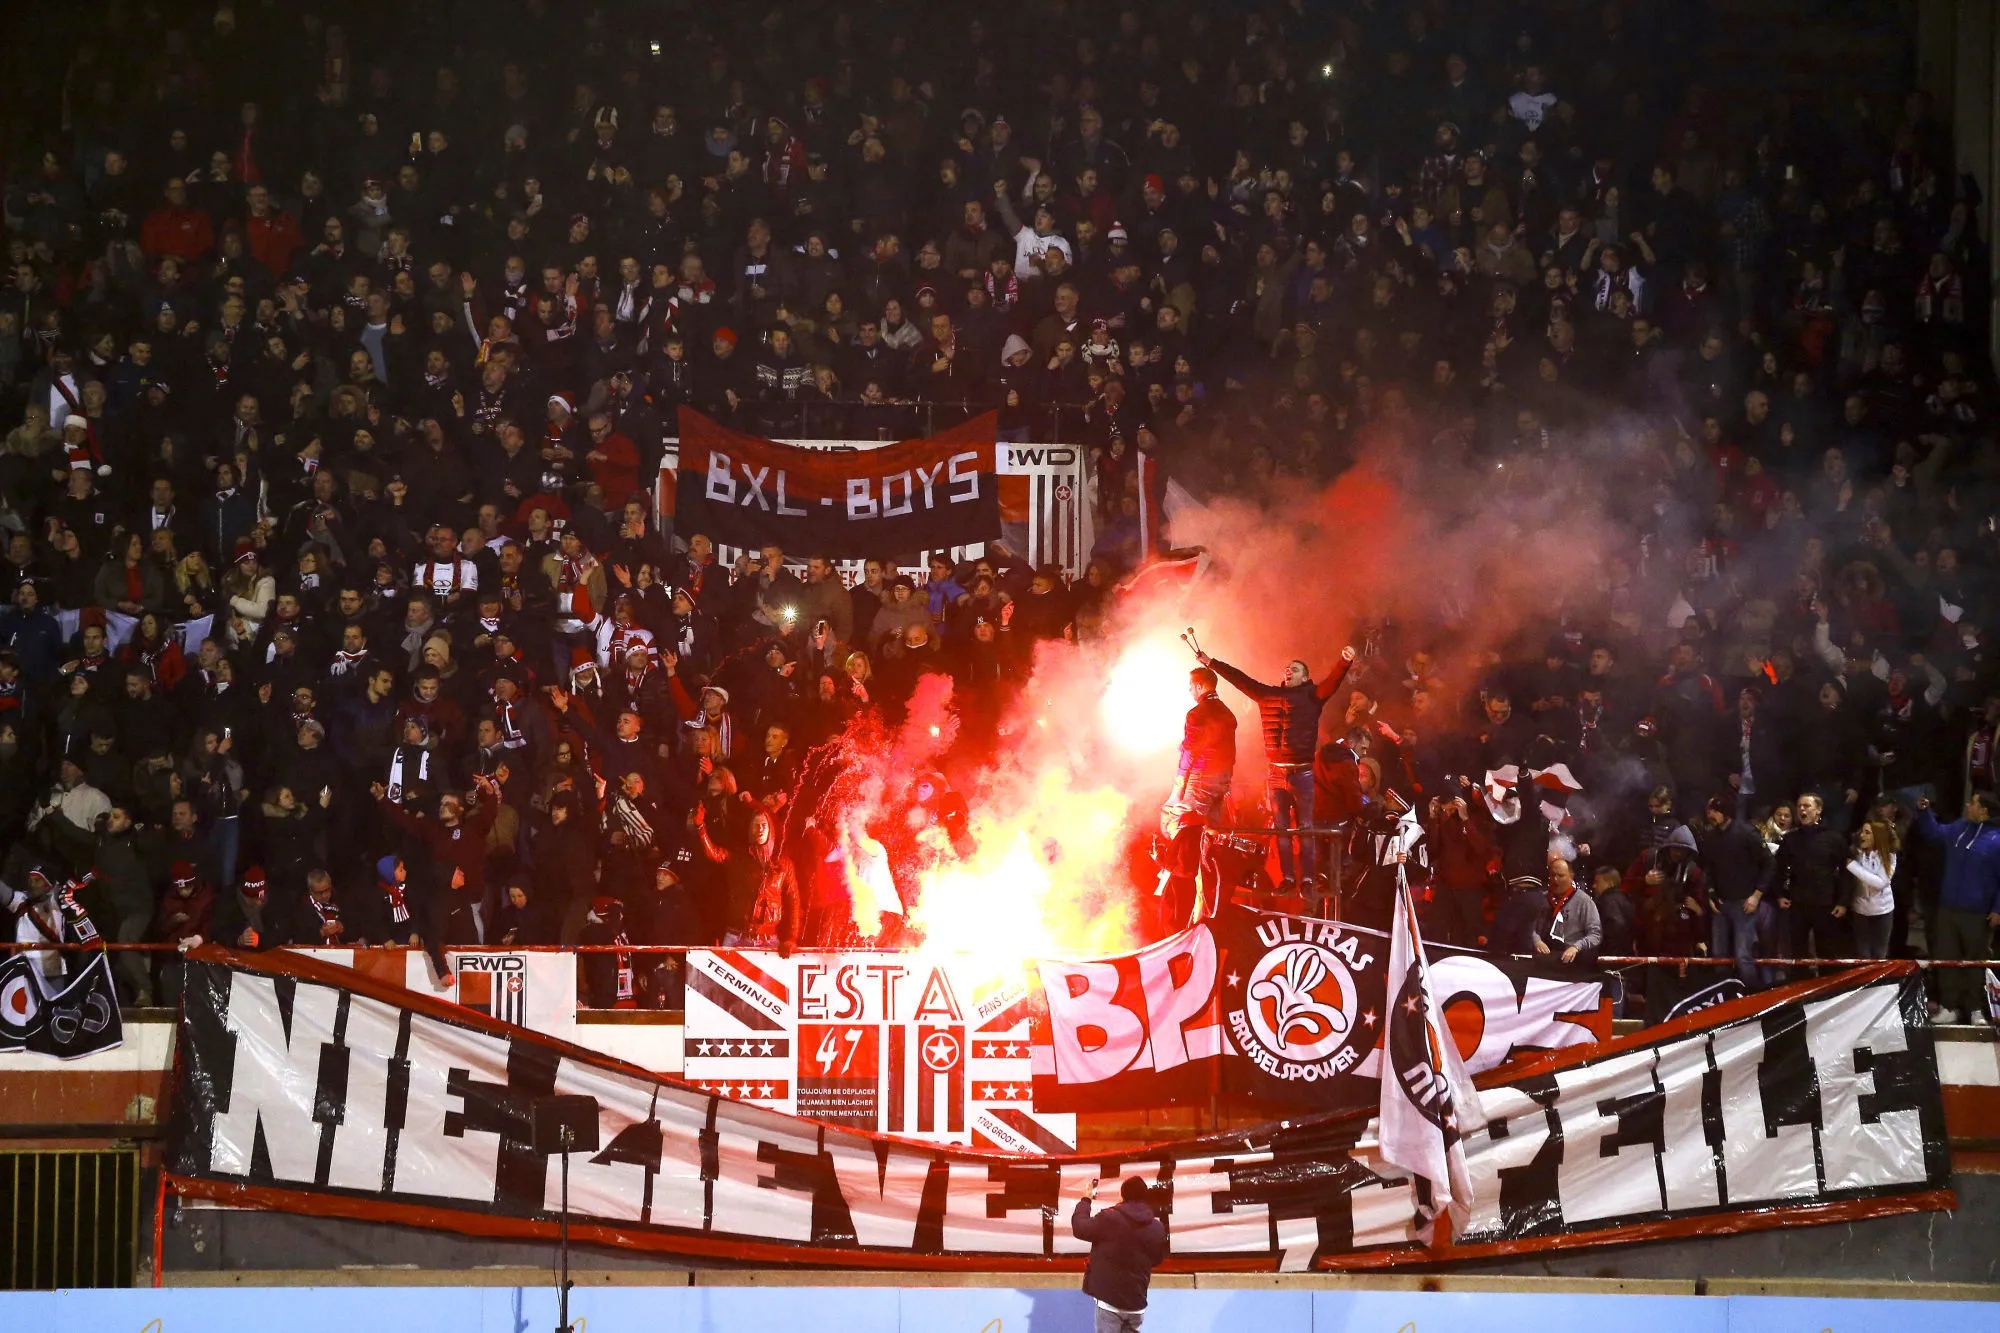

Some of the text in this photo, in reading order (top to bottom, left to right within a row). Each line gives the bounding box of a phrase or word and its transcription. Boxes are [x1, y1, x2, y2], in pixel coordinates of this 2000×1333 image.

[705, 450, 808, 517] BXL
[846, 451, 980, 521] BOYS
[459, 957, 523, 971] RWD
[1255, 917, 1375, 972] ULTRAS
[707, 958, 783, 1015] TERMINUS
[797, 964, 964, 1021] ESTA
[978, 996, 1002, 1019] FANS
[815, 1027, 864, 1075] 47
[1228, 1009, 1360, 1083] BRUSSELSPOWER
[210, 970, 513, 1202] NIE
[838, 1109, 873, 1117] MENTALITÉ
[977, 1115, 993, 1130] 1702
[991, 1125, 1017, 1146] GROOT
